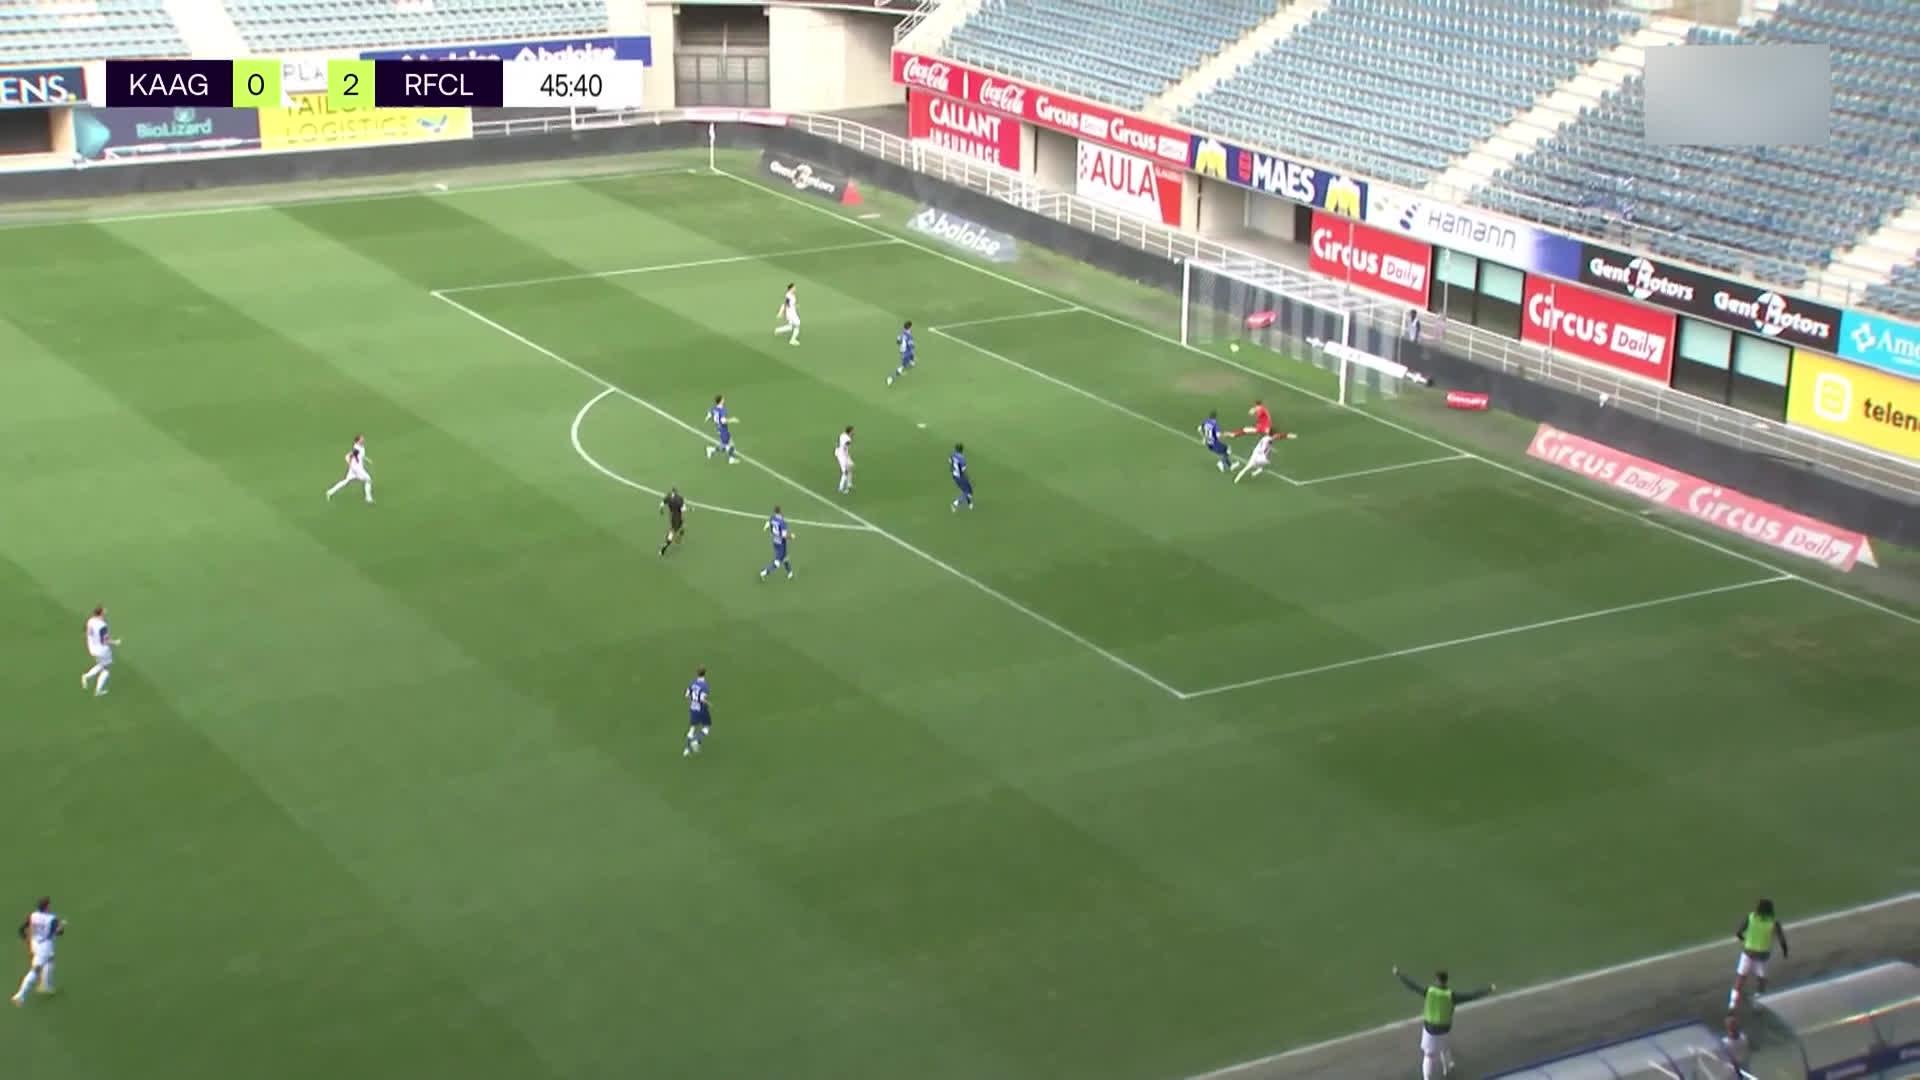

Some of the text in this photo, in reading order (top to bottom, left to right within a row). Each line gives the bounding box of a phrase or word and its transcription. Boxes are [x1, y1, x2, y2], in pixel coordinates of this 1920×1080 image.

[137, 119, 212, 138] BioLizard
[929, 98, 1001, 144] CALLANT
[1091, 151, 1156, 201] AULA
[1252, 152, 1316, 203] MAES
[934, 210, 1001, 256] baloise
[1427, 207, 1516, 250] Hamann
[1312, 227, 1419, 288] Circus Daily
[1589, 257, 1694, 302] Gent Motors
[1528, 293, 1658, 360] Circus Daily
[1713, 291, 1830, 339] Gent Motors
[1864, 397, 1920, 434] telen
[1535, 428, 1840, 562] Circus Daily Circus Daily
